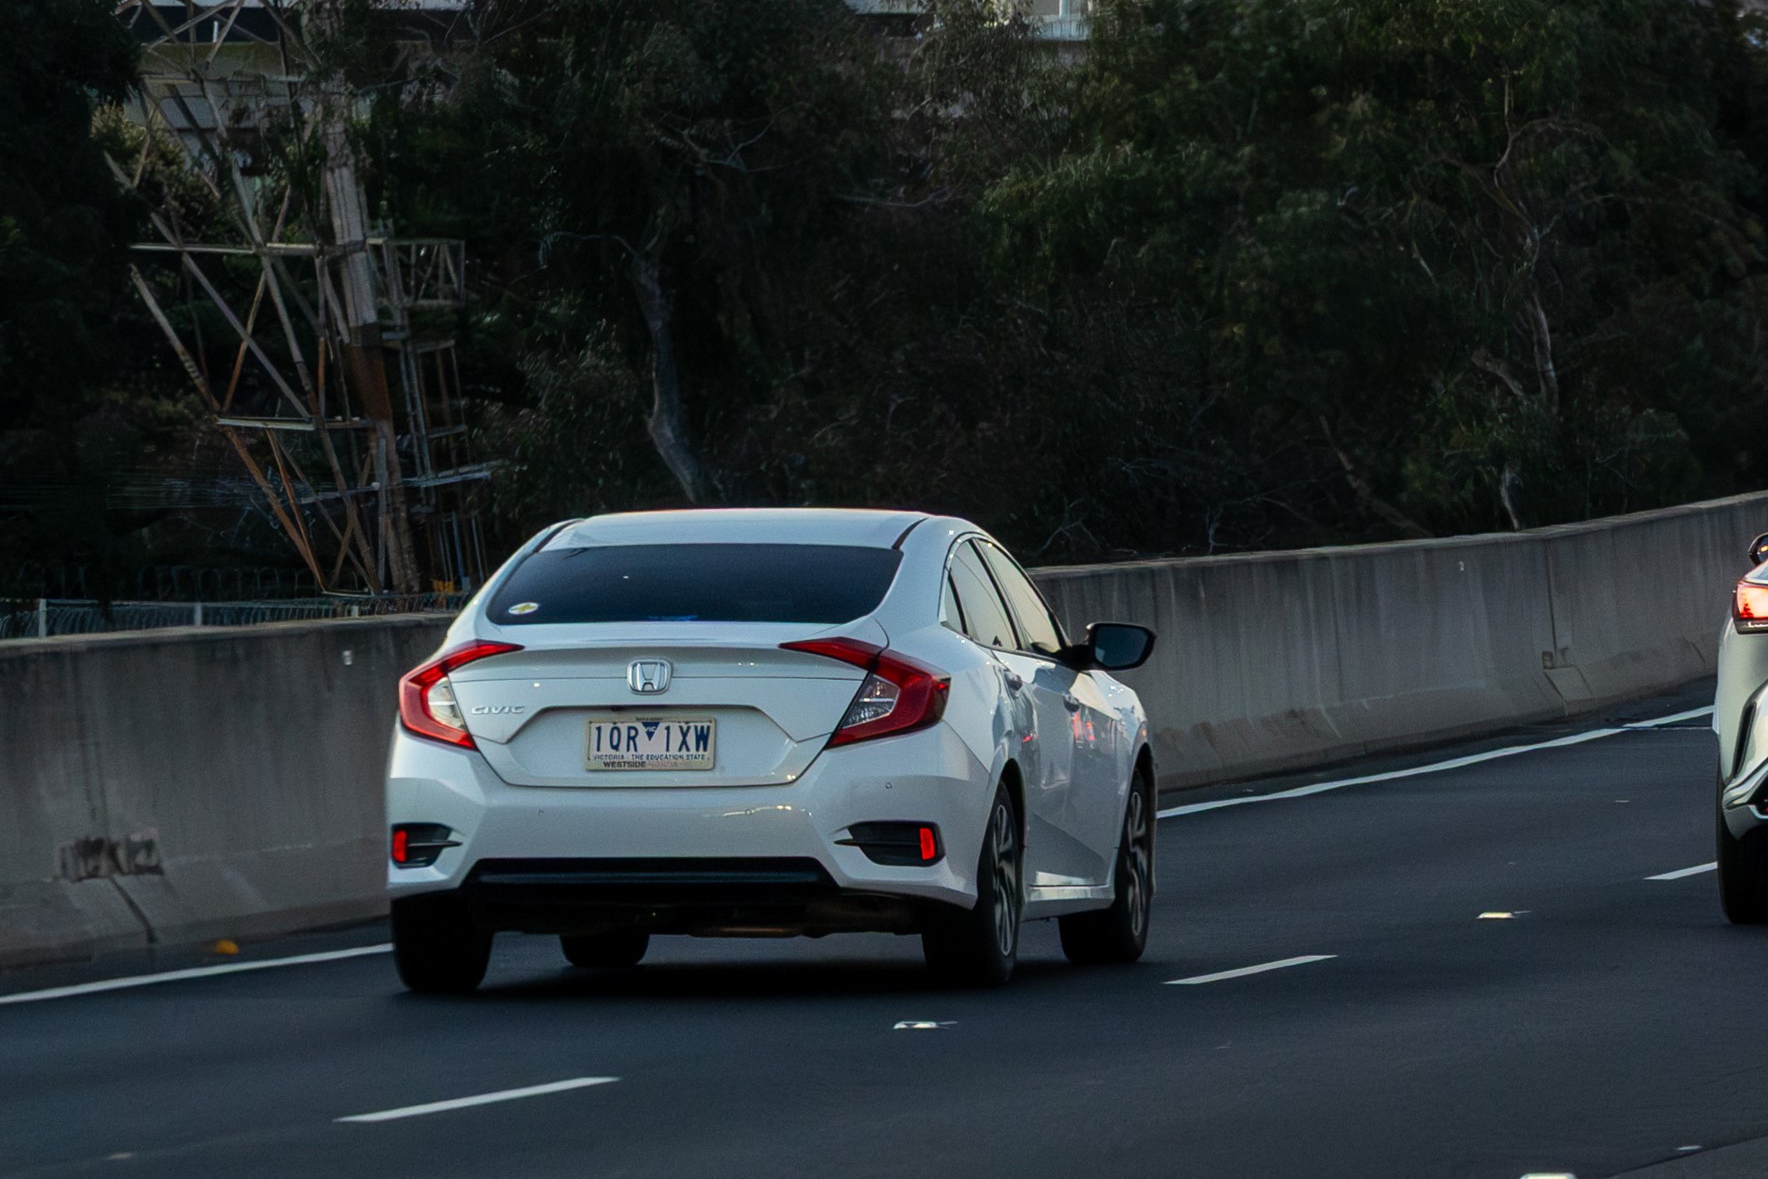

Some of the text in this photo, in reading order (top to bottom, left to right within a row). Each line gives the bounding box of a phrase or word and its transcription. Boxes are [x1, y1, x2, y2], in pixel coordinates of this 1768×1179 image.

[471, 705, 526, 715] CIVIC
[595, 725, 710, 752] 1QR 1XW
